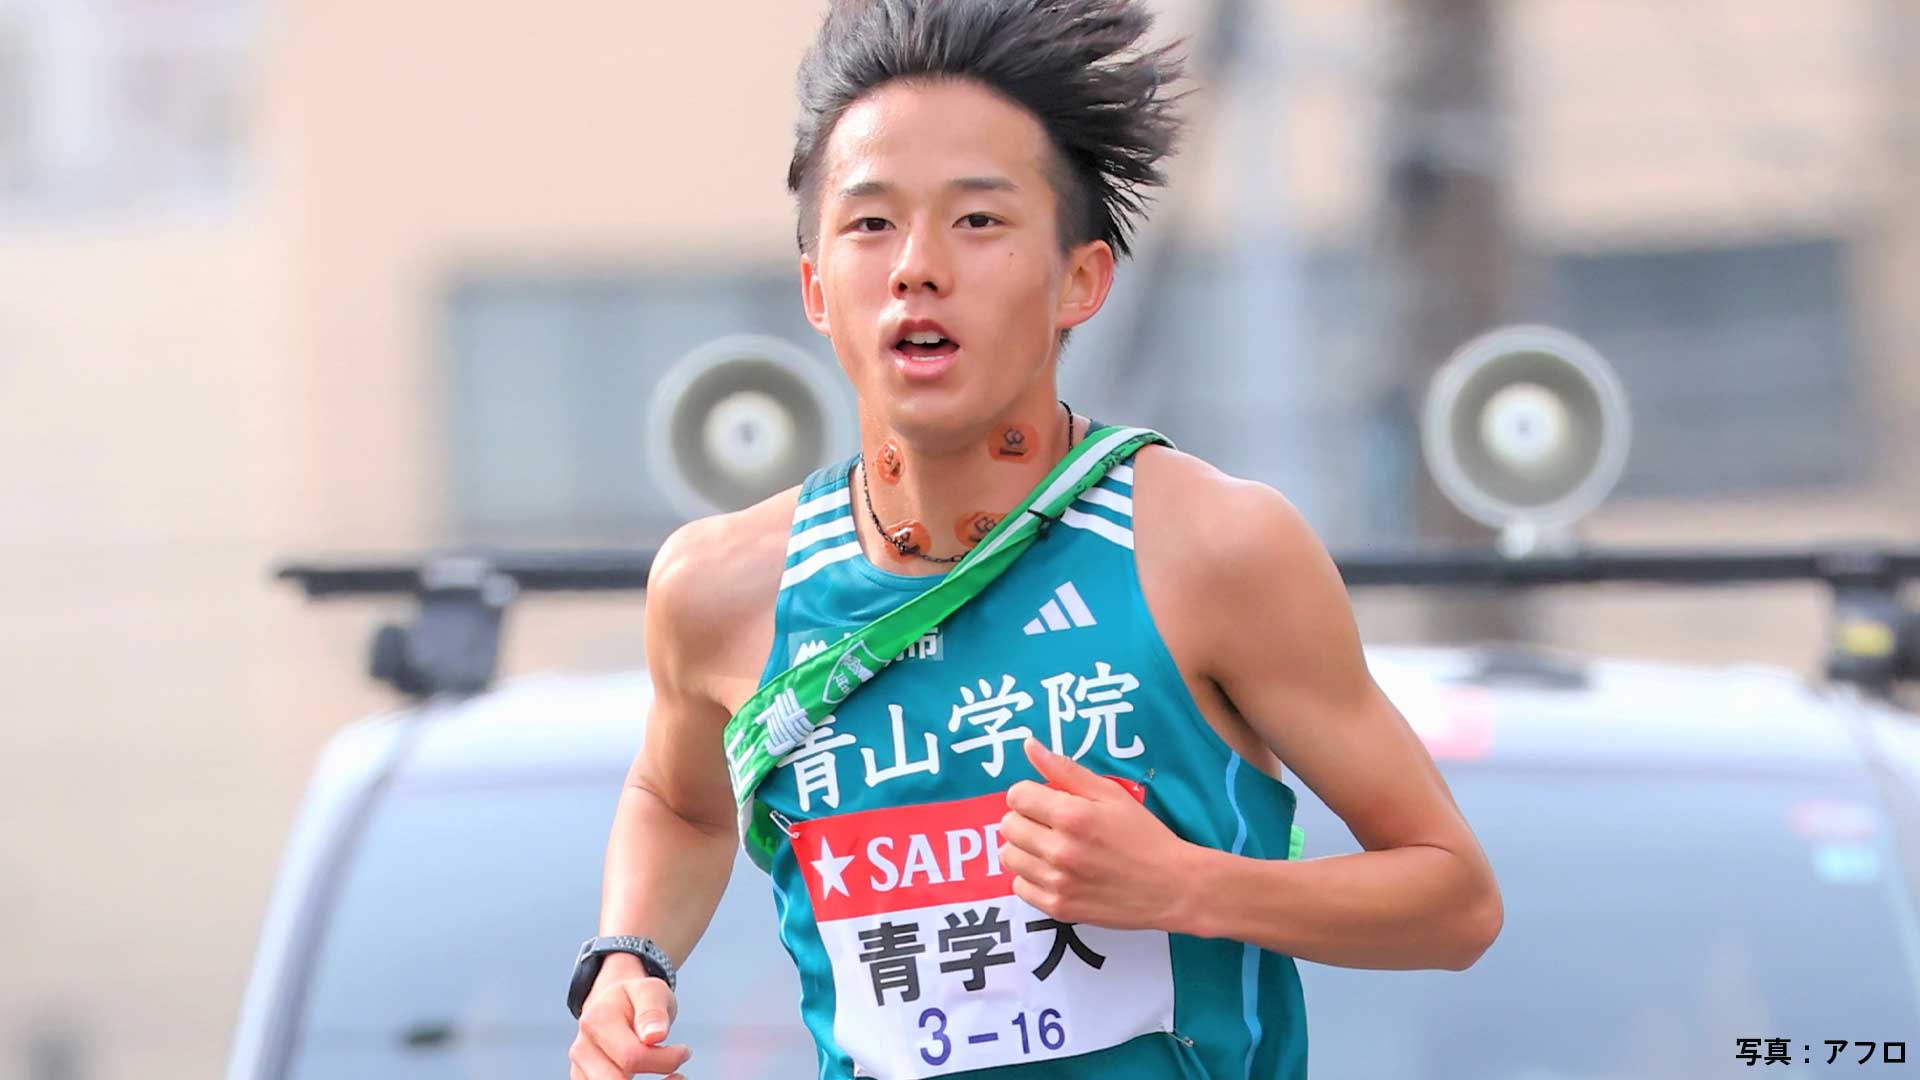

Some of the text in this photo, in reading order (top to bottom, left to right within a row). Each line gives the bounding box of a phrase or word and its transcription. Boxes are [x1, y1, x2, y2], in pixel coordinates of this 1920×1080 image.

[776, 661, 1146, 812] 青山学院
[858, 906, 1106, 1007] 青学大
